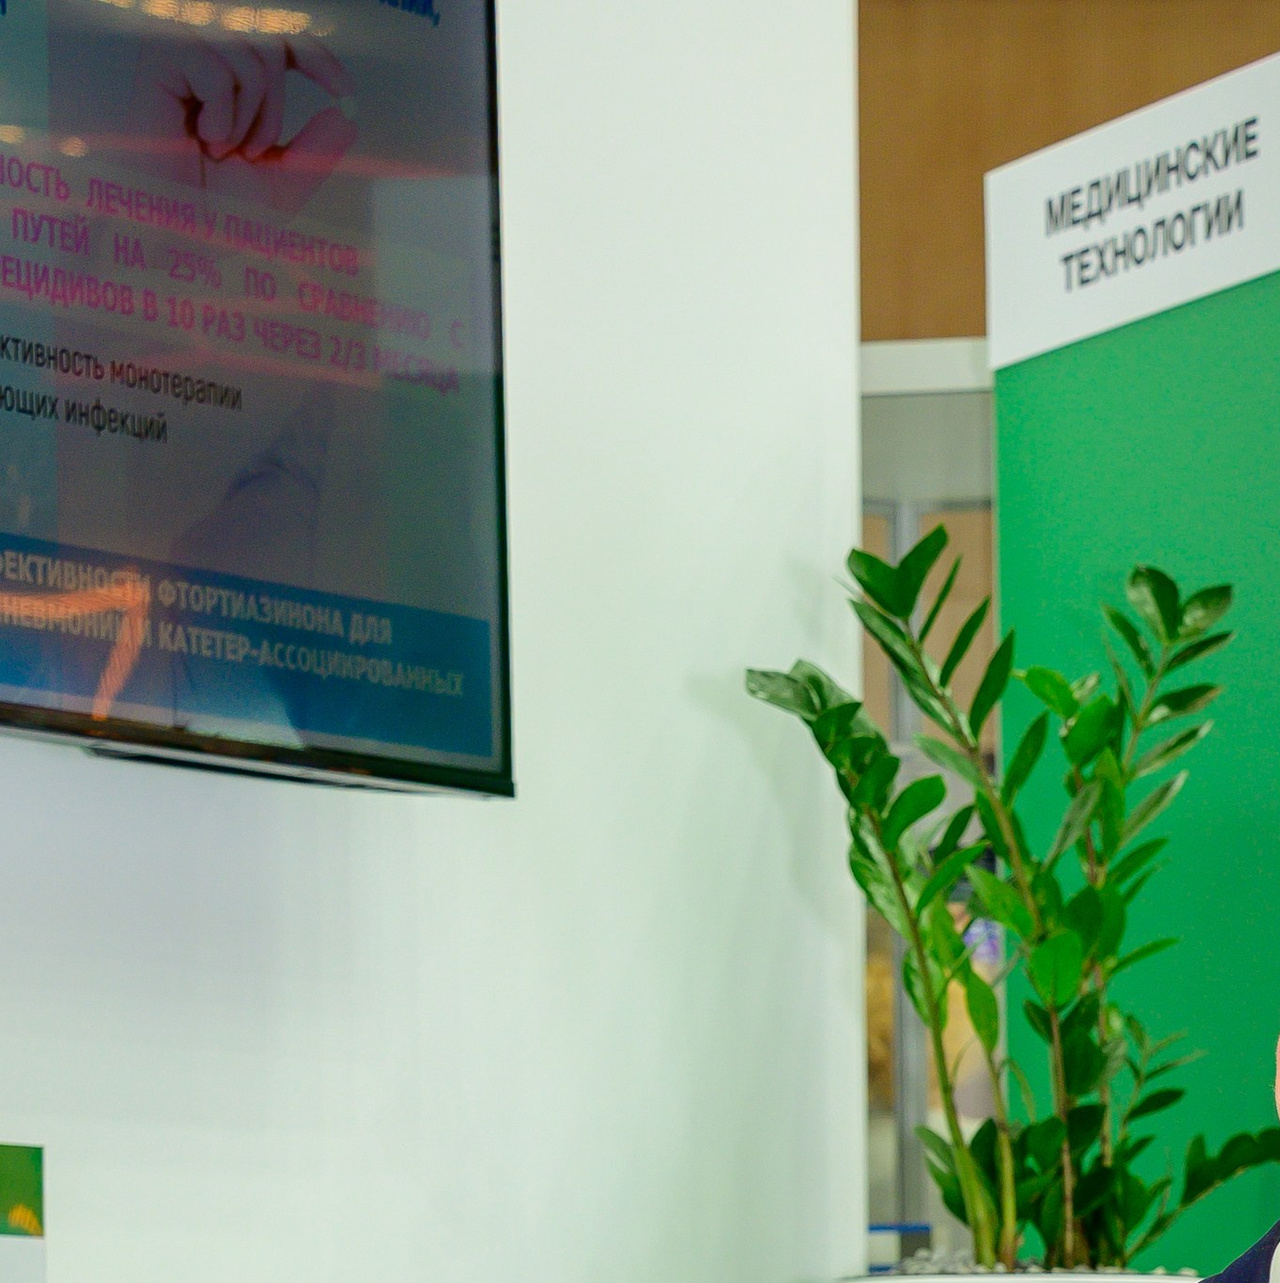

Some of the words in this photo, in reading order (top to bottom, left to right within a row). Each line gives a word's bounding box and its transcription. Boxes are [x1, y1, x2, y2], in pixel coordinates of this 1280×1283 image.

[0, 154, 70, 201] ОСТЬ
[87, 177, 196, 234] ЛЕЧЕНИЯ
[203, 210, 218, 240] У
[225, 214, 359, 277] ПАЦИЕНТОВ
[1044, 117, 1259, 237] МЕДИЦИНСКИЕ
[12, 208, 90, 257] ПУТЕЙ
[112, 231, 147, 270] НА
[168, 246, 222, 289] 25%
[243, 266, 277, 302] ПО
[449, 318, 464, 349] С
[1060, 190, 1245, 293] ТЕХНОЛОГИИ
[1, 254, 135, 317] ЕЦИДИВОВ
[143, 288, 158, 323] В
[167, 296, 195, 330] 10
[202, 304, 245, 343] РАЗ
[253, 317, 321, 361] ЧЕРЕЗ
[329, 334, 366, 372] 2/3
[64, 396, 168, 444] инфекций
[109, 359, 243, 411] монотерапии
[158, 579, 344, 638] ФТОРТИАЗИНОНА
[350, 613, 392, 646] ДЛЯ
